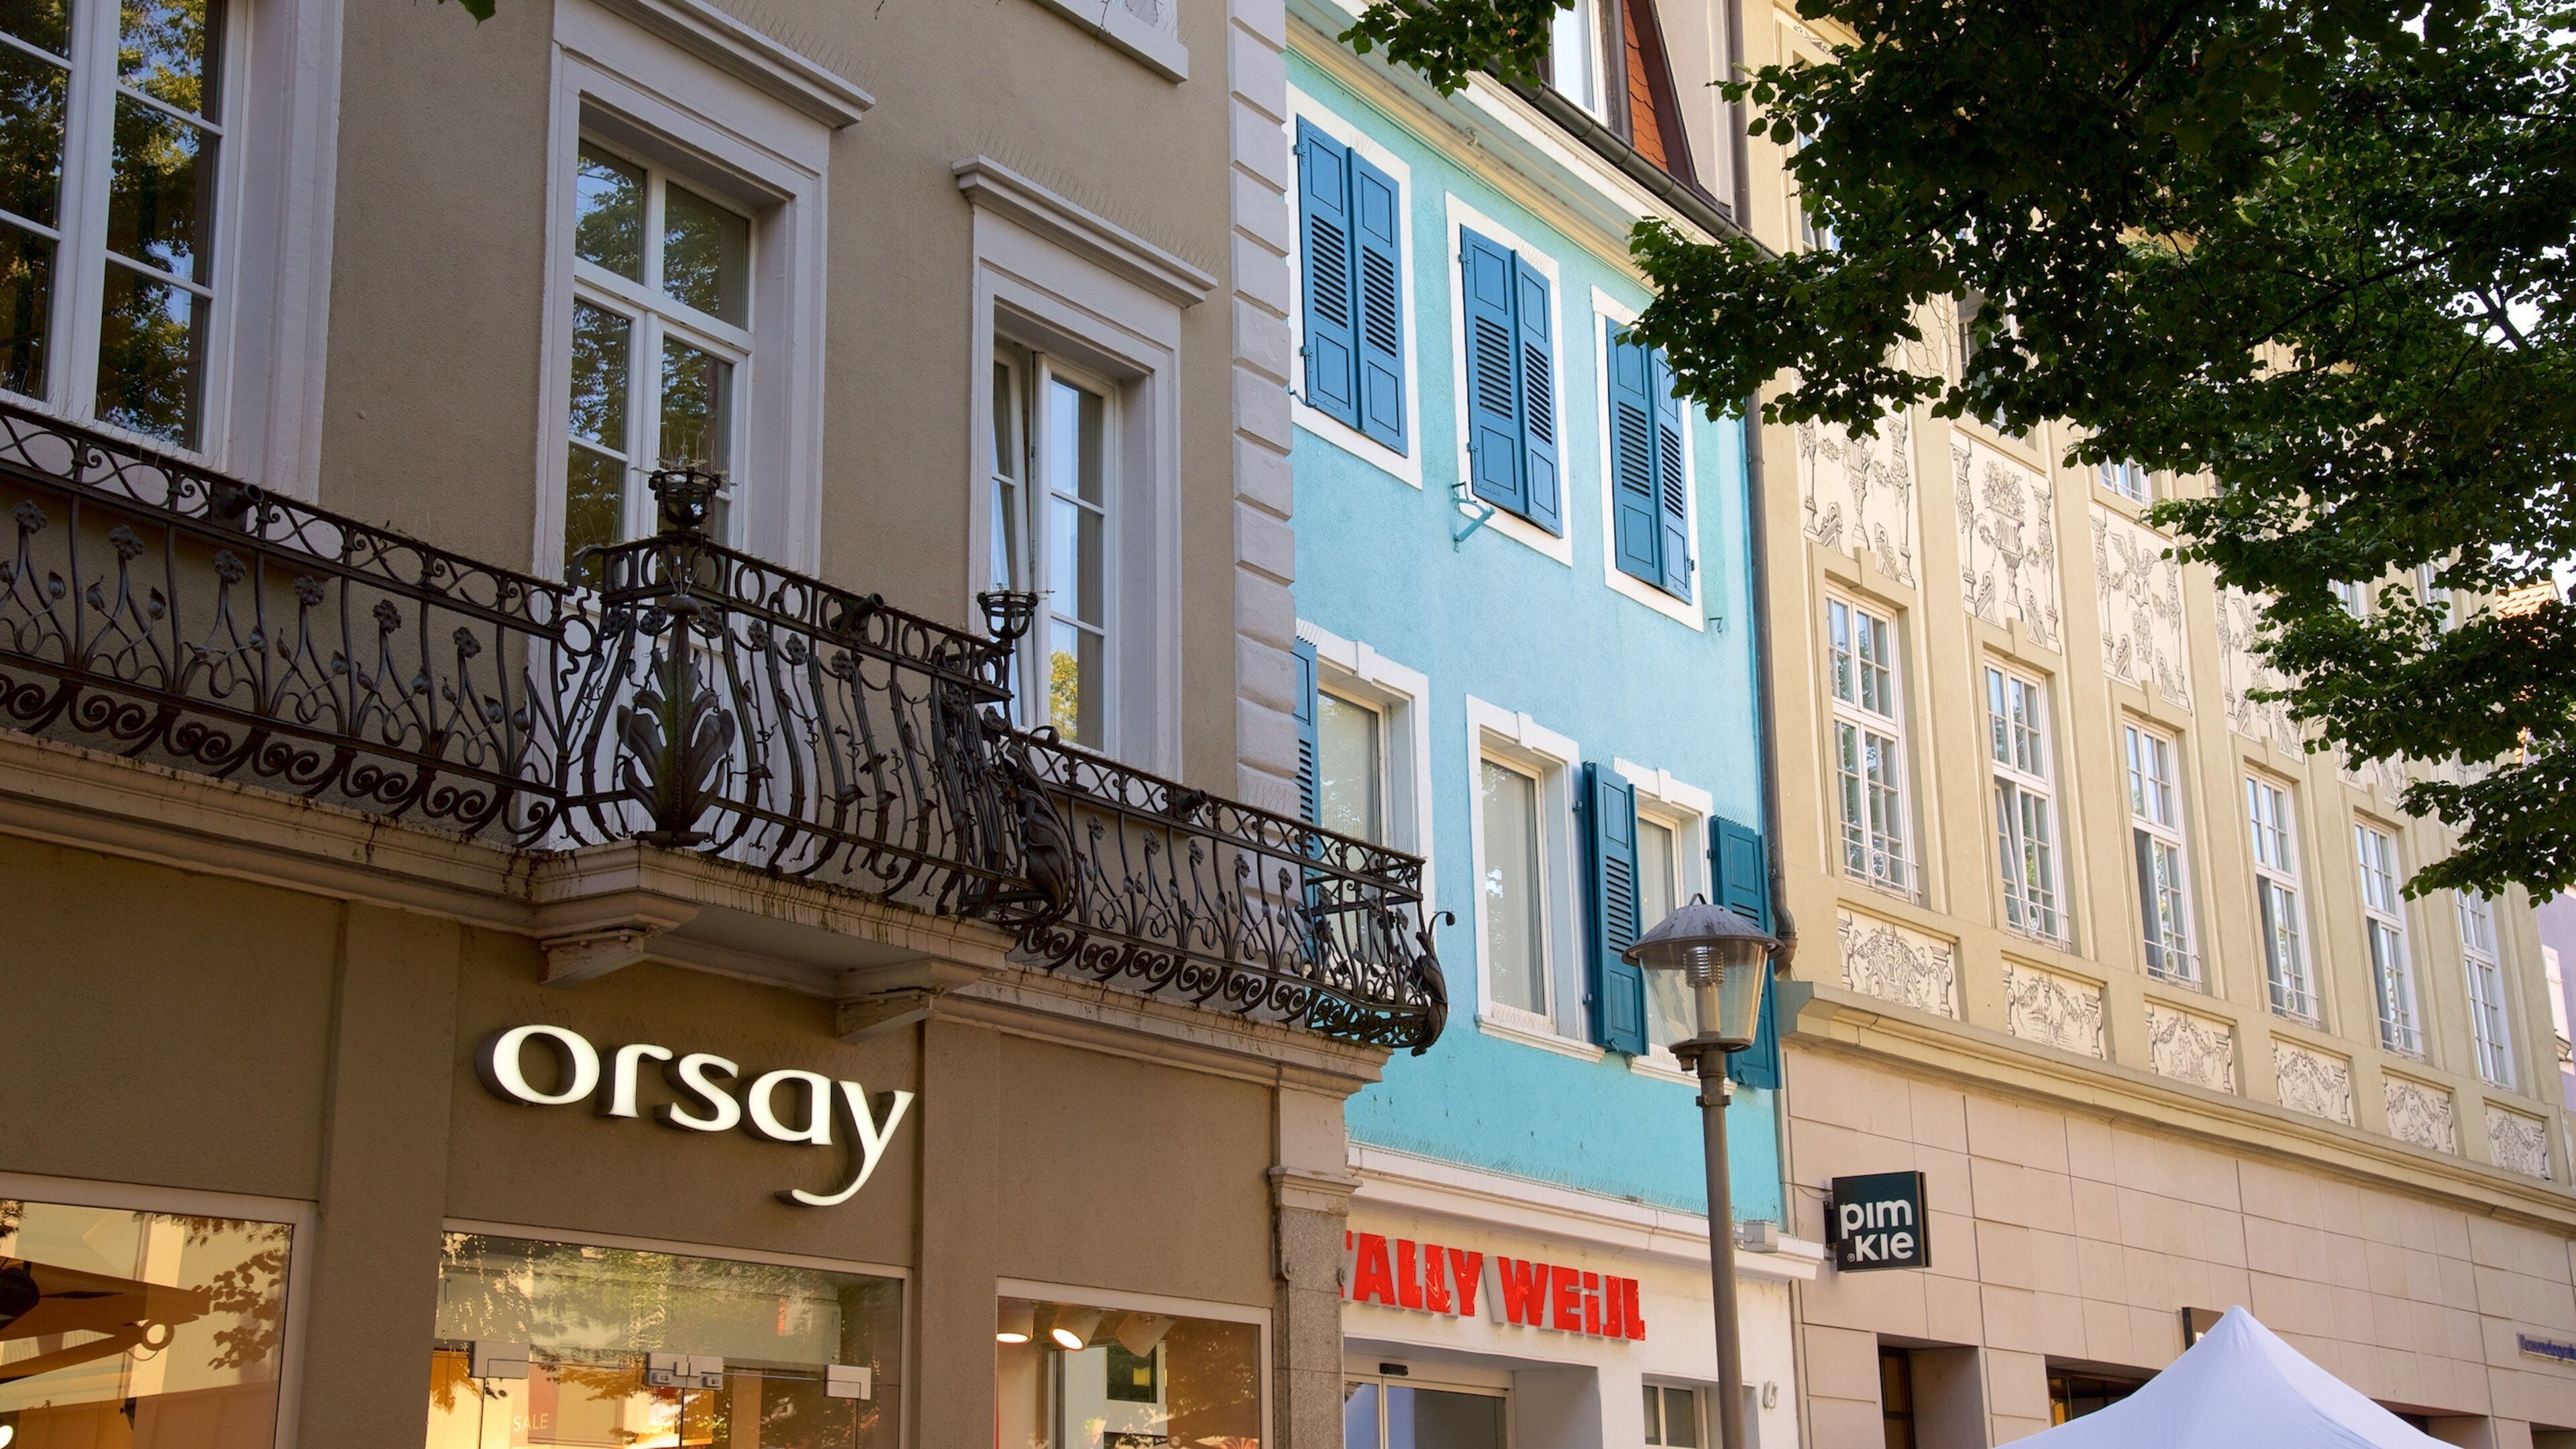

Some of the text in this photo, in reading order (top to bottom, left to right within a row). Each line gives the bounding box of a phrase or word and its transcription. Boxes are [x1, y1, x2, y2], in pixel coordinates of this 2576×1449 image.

[492, 1024, 916, 1207] orsay
[1839, 1199, 1913, 1240] pim
[513, 1412, 549, 1432] SALE
